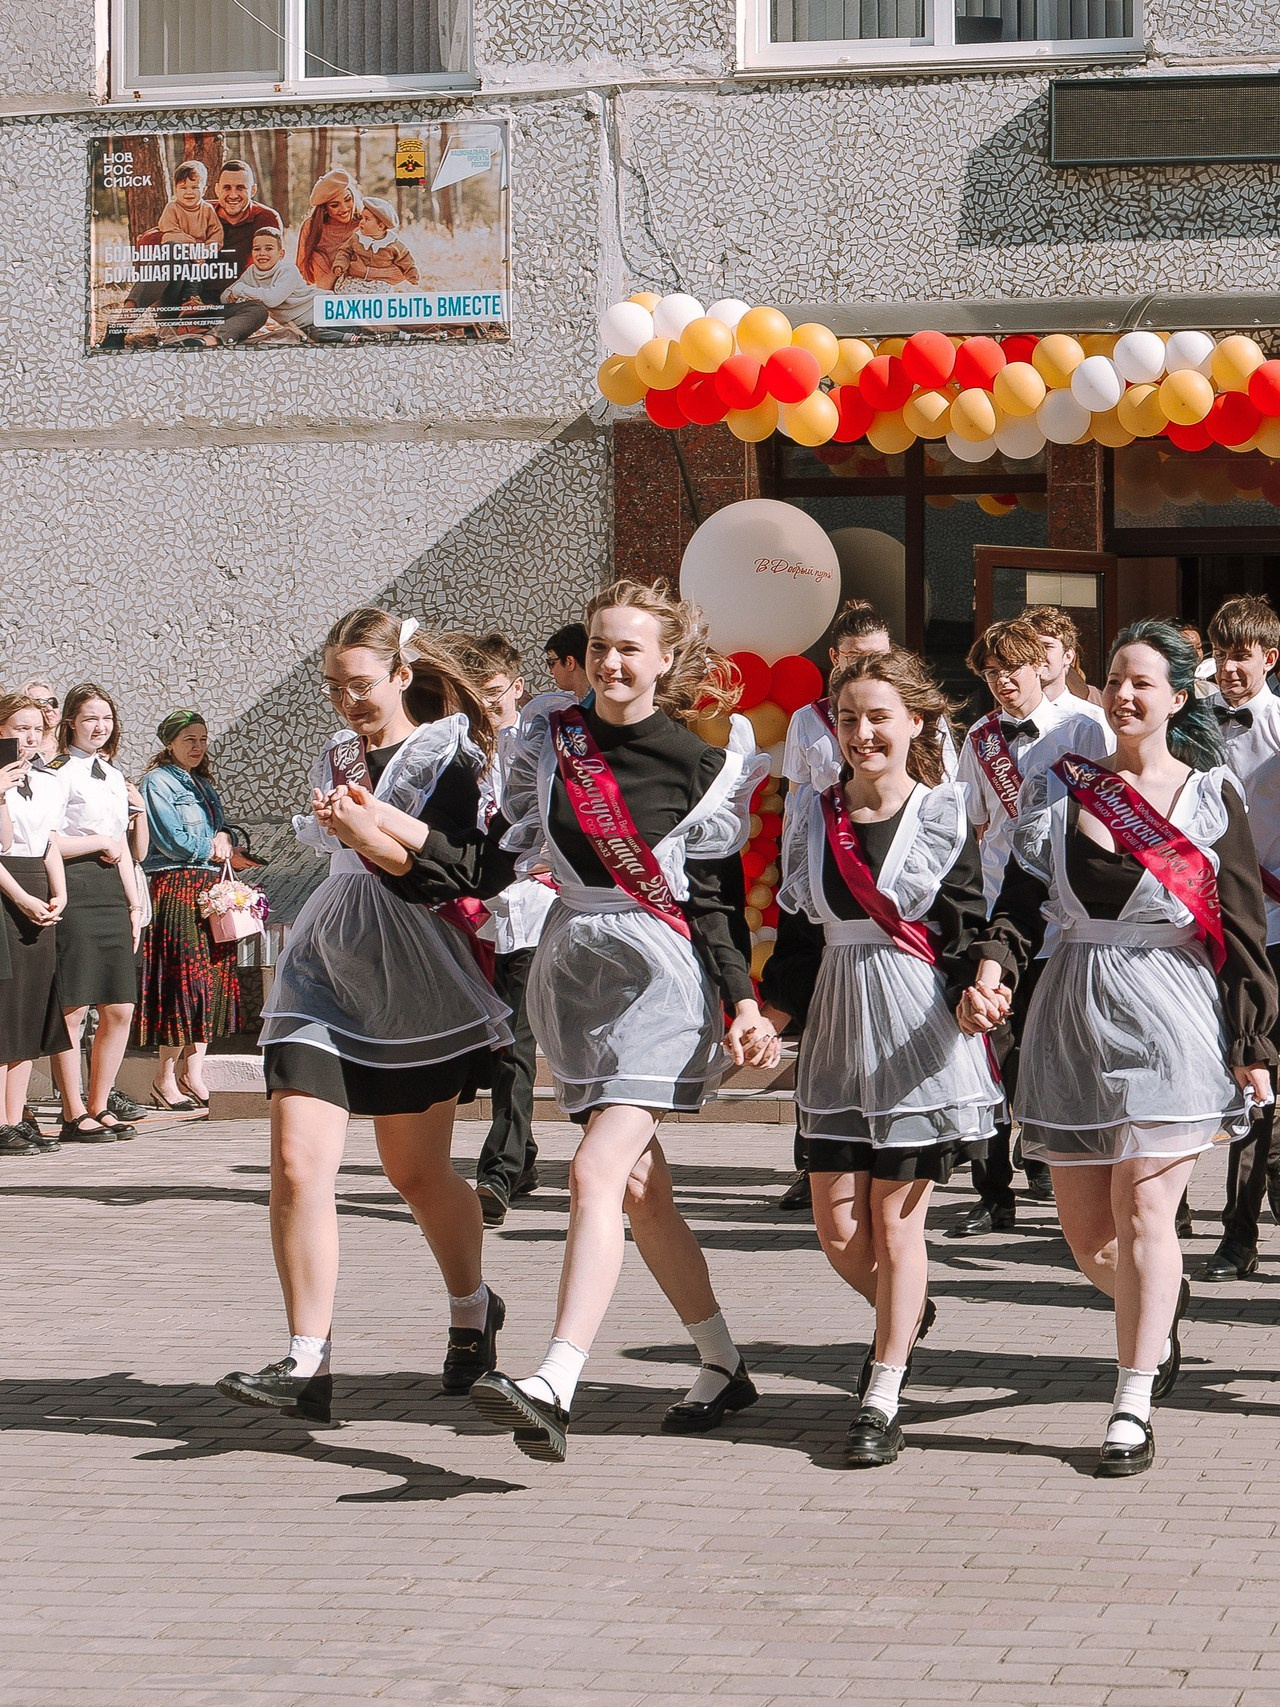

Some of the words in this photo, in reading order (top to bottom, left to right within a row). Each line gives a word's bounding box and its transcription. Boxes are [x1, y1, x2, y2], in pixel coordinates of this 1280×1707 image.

[104, 152, 134, 164] НОВ
[104, 164, 134, 176] РОС
[104, 176, 152, 188] СИЙСК
[104, 244, 170, 263] БОЛЬШАЯ
[173, 242, 219, 260] СЕМЬЯ
[104, 264, 170, 283] БОЛЬШАЯ
[173, 262, 238, 282] РАДОСТЬ!
[324, 299, 383, 320] ВАЖНО
[388, 297, 432, 318] БЫТЬ
[437, 295, 501, 316] ВМЕСТЕ
[1092, 800, 1112, 818] МАОУ
[585, 818, 600, 838] СОШ
[596, 838, 611, 858] №33
[636, 875, 682, 918] 202
[1187, 868, 1222, 918] 202
